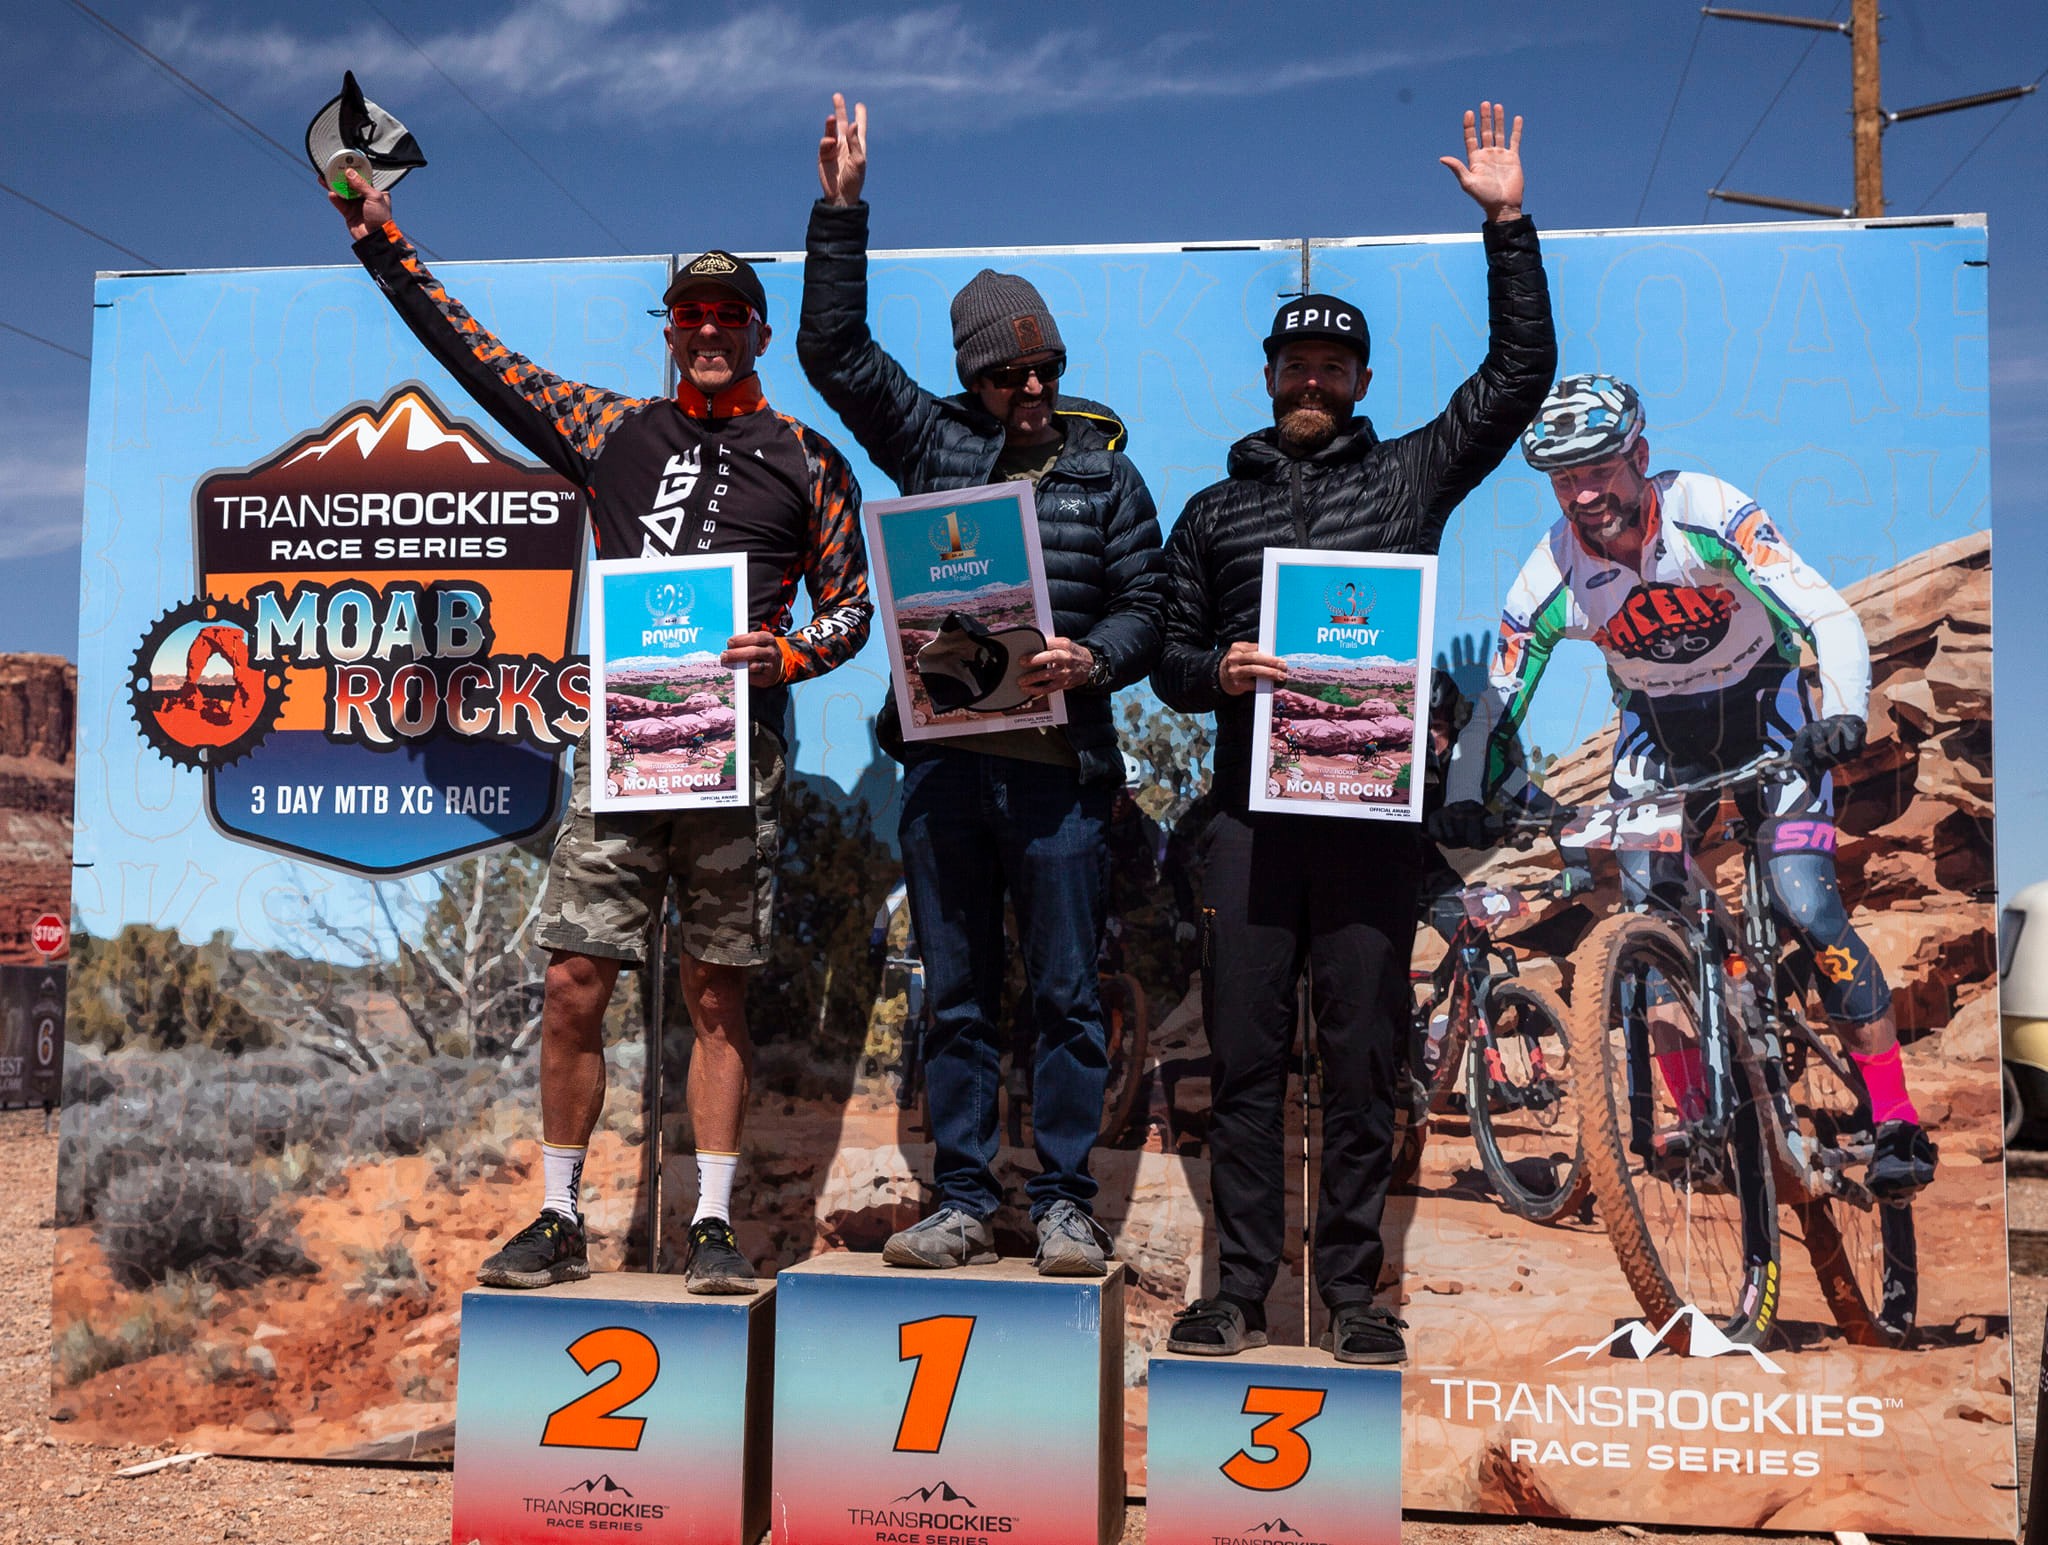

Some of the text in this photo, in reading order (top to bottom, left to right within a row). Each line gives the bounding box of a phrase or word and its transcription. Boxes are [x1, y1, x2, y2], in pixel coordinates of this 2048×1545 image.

[1285, 308, 1352, 331] EPIC
[697, 444, 731, 550] ESPORT
[271, 537, 507, 560] RACE SERIES
[929, 560, 990, 582] ROWDY
[254, 588, 485, 662] MOAB
[1317, 627, 1380, 646] ROWDY
[642, 627, 699, 647] ROWDY
[333, 662, 590, 743] ROCKS
[624, 773, 721, 790] MOAB ROCKS
[1287, 780, 1393, 797] MOAB ROCKS
[251, 785, 510, 814] 3 DAY MTB XC RACE
[34, 925, 63, 942] STOP
[37, 1018, 54, 1066] 6
[539, 1326, 660, 1451] 2
[893, 1314, 977, 1454] 1
[1219, 1385, 1328, 1492] 3
[1509, 1438, 1820, 1478] RACE SERIES
[547, 1518, 643, 1532] RACE SERIES
[876, 1532, 989, 1545] RACE SERIES
